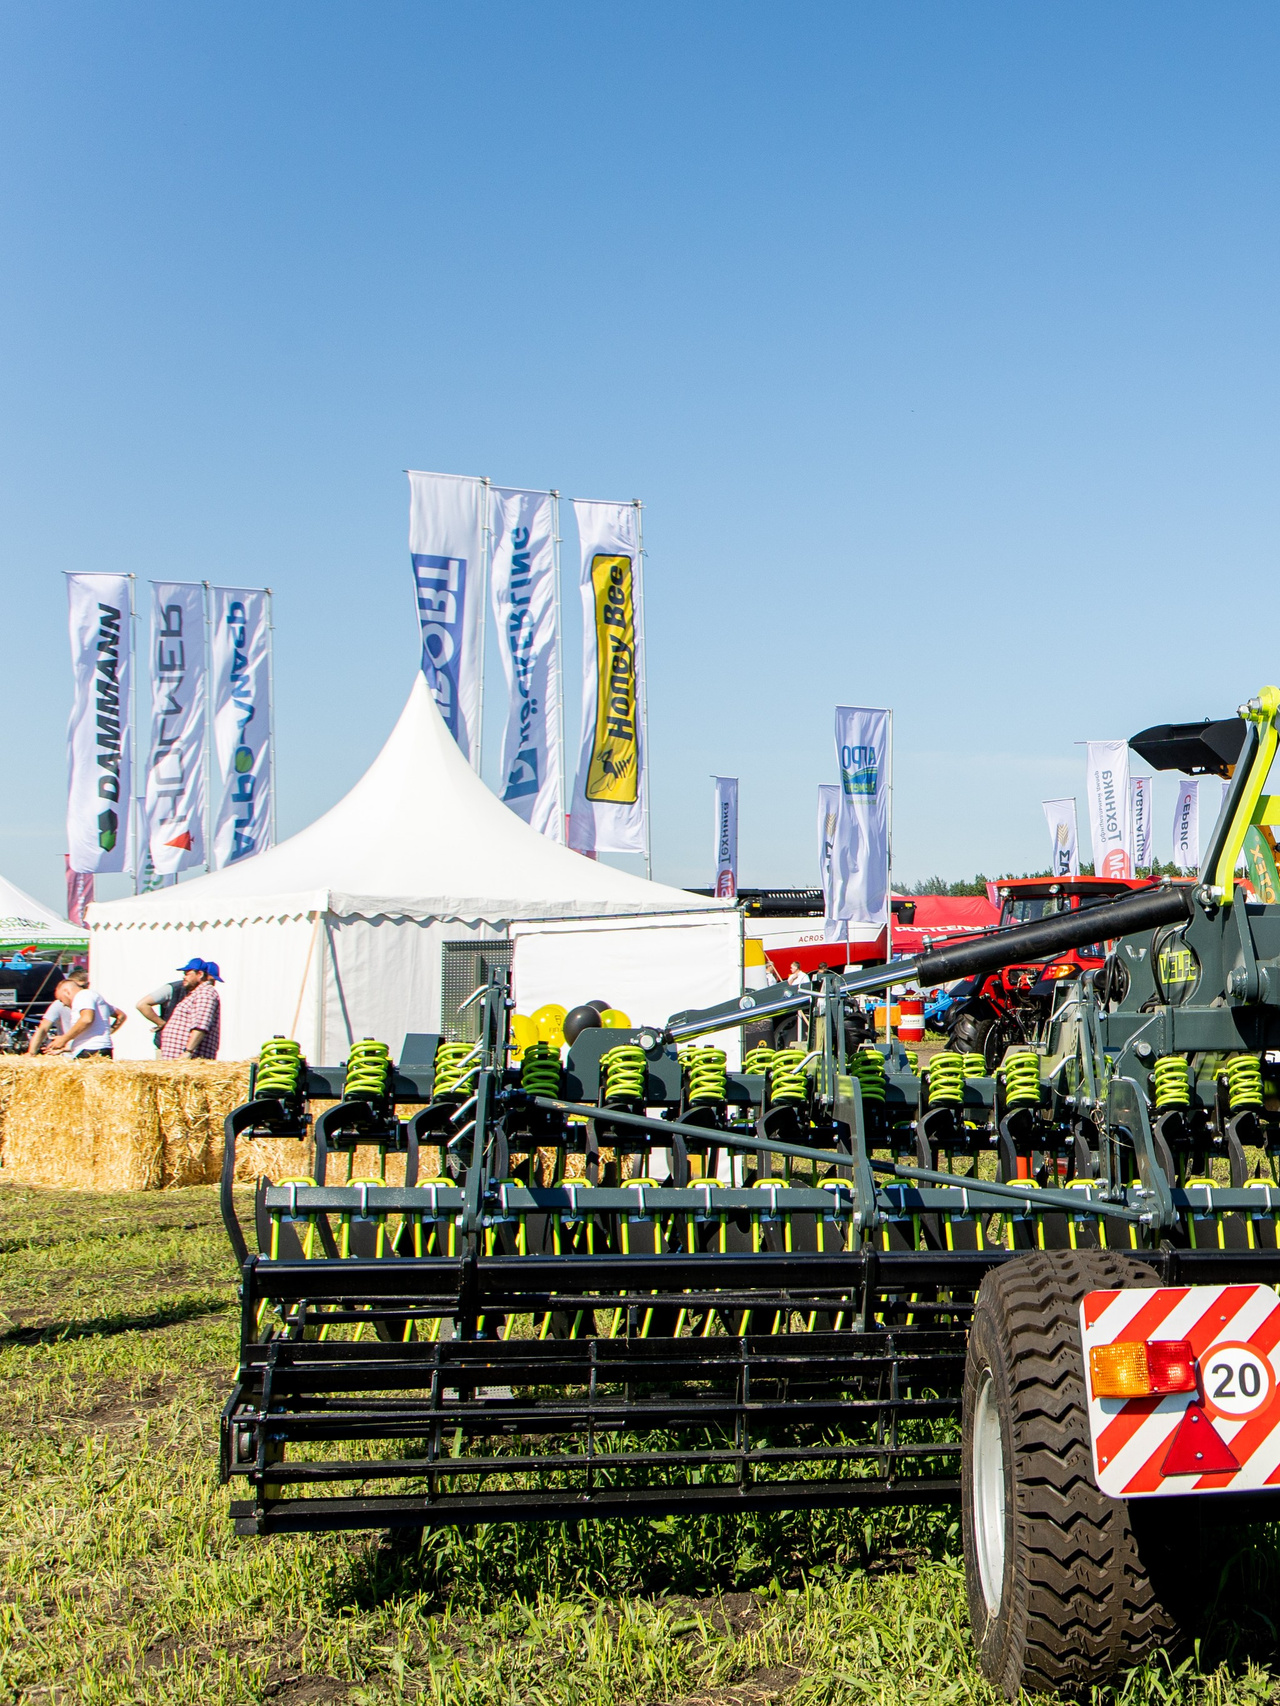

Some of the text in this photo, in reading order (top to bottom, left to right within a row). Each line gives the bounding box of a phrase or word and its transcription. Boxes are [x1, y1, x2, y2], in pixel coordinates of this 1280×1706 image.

[604, 565, 635, 742] Honey Bee
[97, 602, 121, 803] DAMMANN
[798, 934, 824, 943] ACROS
[894, 924, 992, 933] РОСТСЕЛЬ
[1211, 1363, 1261, 1398] 20
